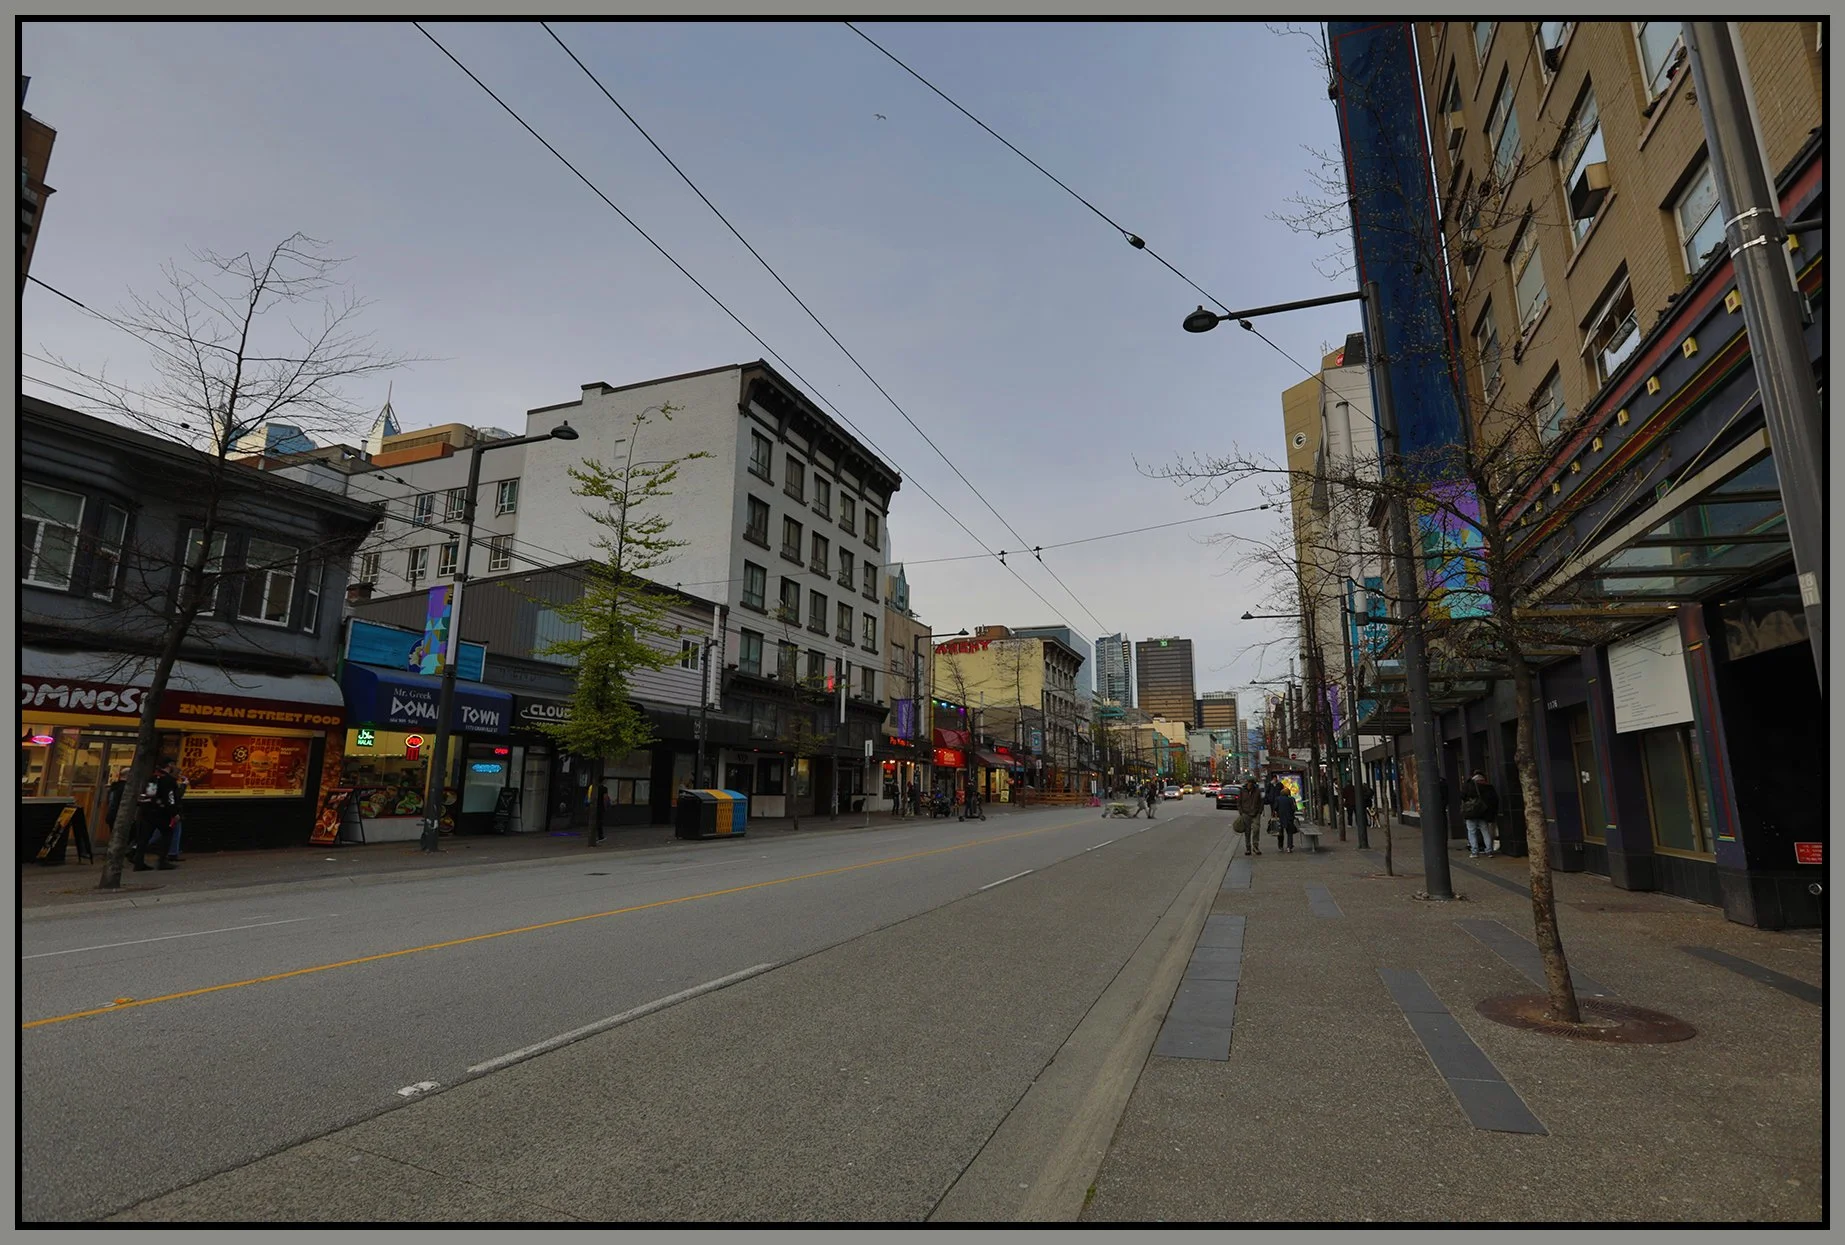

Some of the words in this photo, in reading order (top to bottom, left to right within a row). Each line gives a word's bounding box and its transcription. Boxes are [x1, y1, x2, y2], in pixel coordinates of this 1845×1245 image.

[394, 688, 407, 697] Mr.
[409, 690, 432, 700] Greek
[179, 703, 245, 718] INDIAN
[246, 709, 302, 723] STREET
[303, 714, 341, 725] FOOD
[461, 705, 500, 726] TOWN
